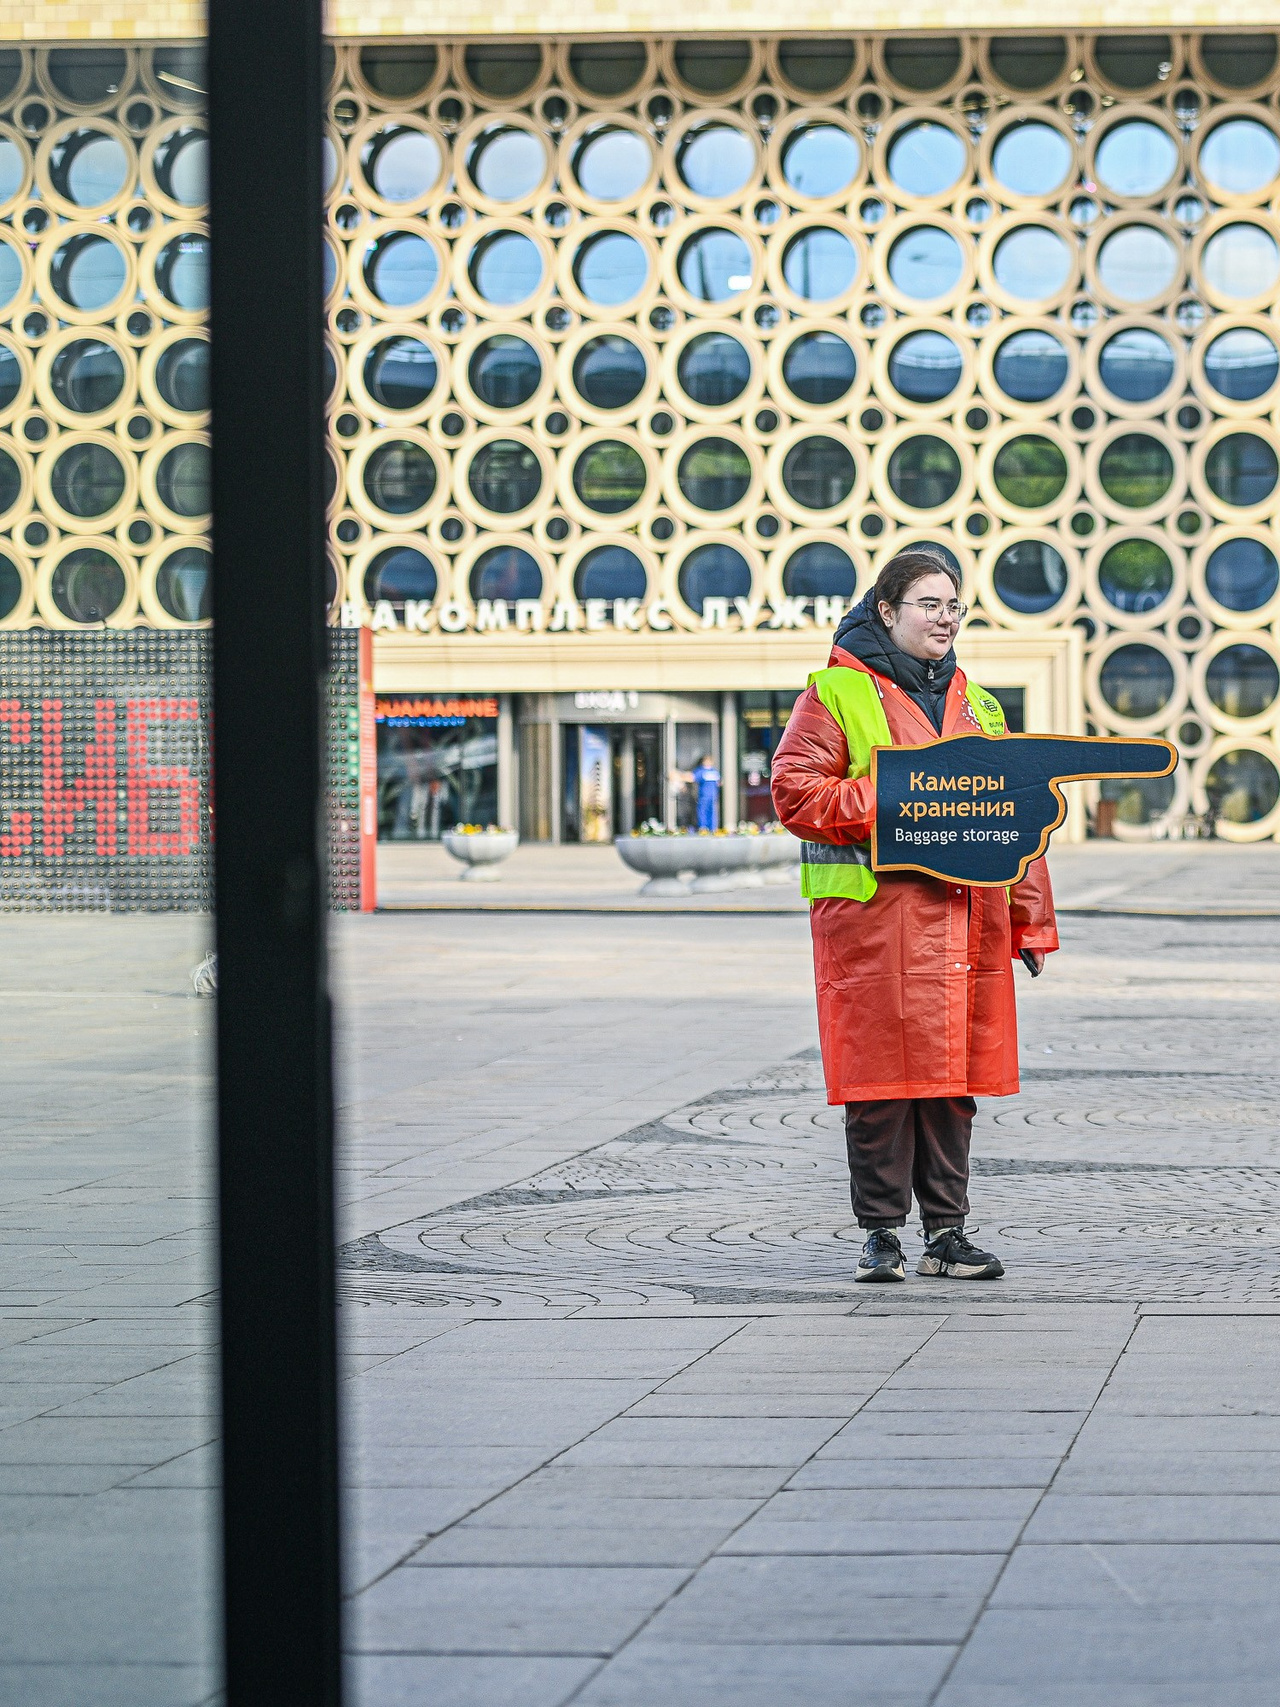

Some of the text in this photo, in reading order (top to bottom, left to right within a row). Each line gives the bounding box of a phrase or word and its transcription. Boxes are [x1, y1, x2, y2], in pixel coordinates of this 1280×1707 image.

[327, 596, 845, 632] ВАКОМПЛЕКС ЛУЖН
[909, 771, 1005, 796] Камеры
[899, 801, 1015, 822] хранения
[895, 828, 1019, 845] Baggage storage
